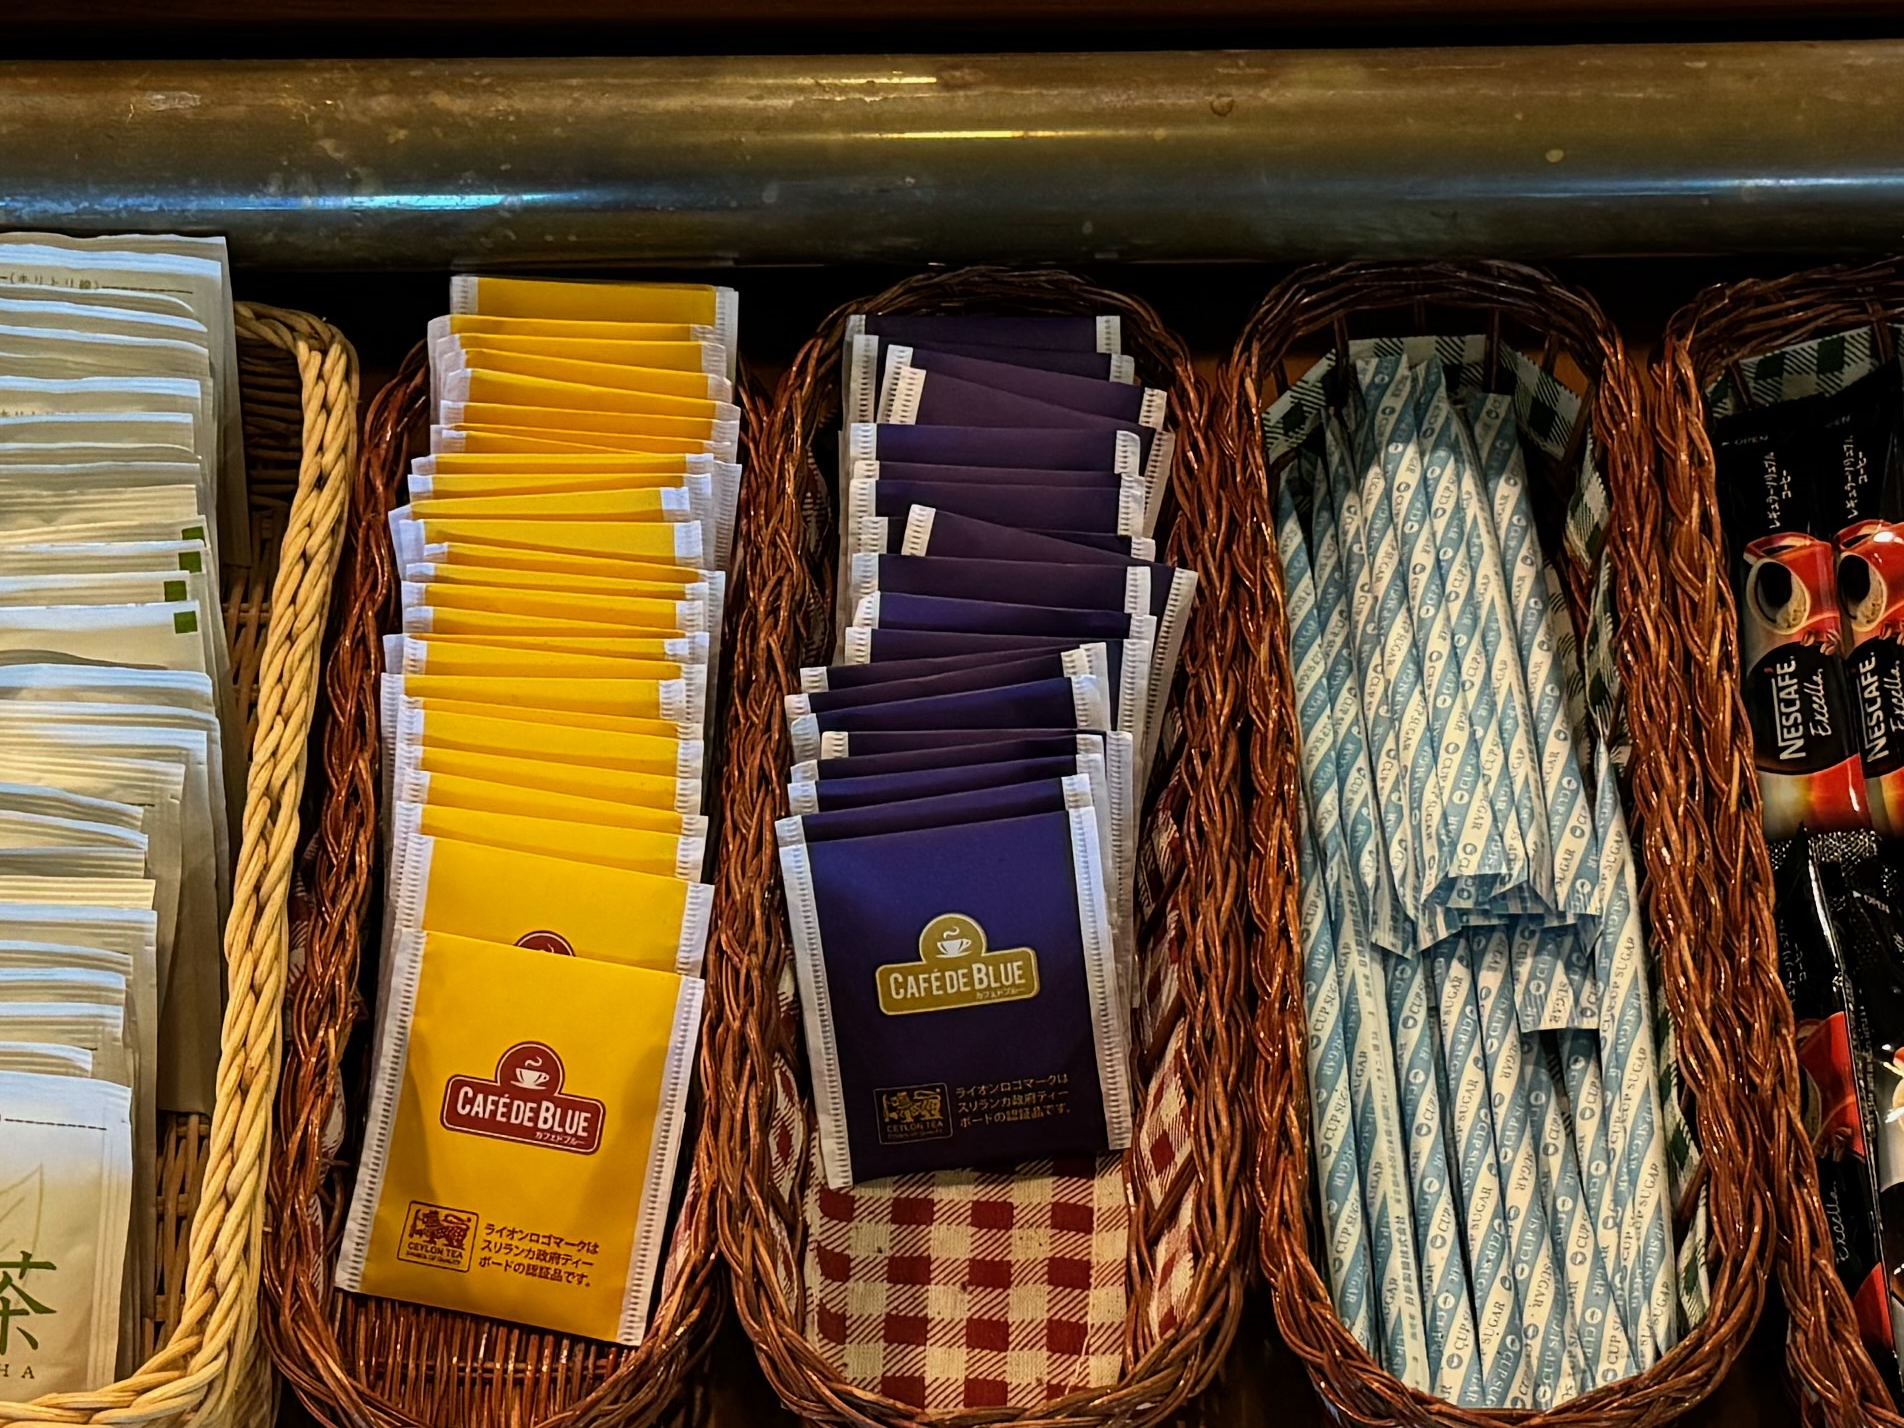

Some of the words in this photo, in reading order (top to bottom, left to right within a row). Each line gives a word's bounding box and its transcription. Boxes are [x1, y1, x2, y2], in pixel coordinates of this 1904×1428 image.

[1810, 668, 1826, 737] Excella
[889, 967, 942, 1000] CAFÉ
[945, 969, 970, 994] DE
[972, 960, 1026, 990] BLUE
[955, 1072, 1069, 1099] ライオンロゴマークは
[1627, 1046, 1648, 1092] SUGAR
[456, 1085, 510, 1124] CAFÉ
[510, 1101, 536, 1128] DE
[537, 1100, 592, 1138] BLUE
[1457, 1078, 1479, 1122] SUGAR
[1639, 1161, 1661, 1208] SUGAR
[1471, 1186, 1493, 1231] SUGAR
[407, 1241, 444, 1256] CEYLON
[445, 1247, 464, 1260] TEA
[480, 1239, 595, 1269] スリランカ政府ティー
[484, 1222, 600, 1254] ライオンロゴマークは
[479, 1255, 591, 1287] ボードの認証品です。
[1482, 1300, 1505, 1348] SUGAR
